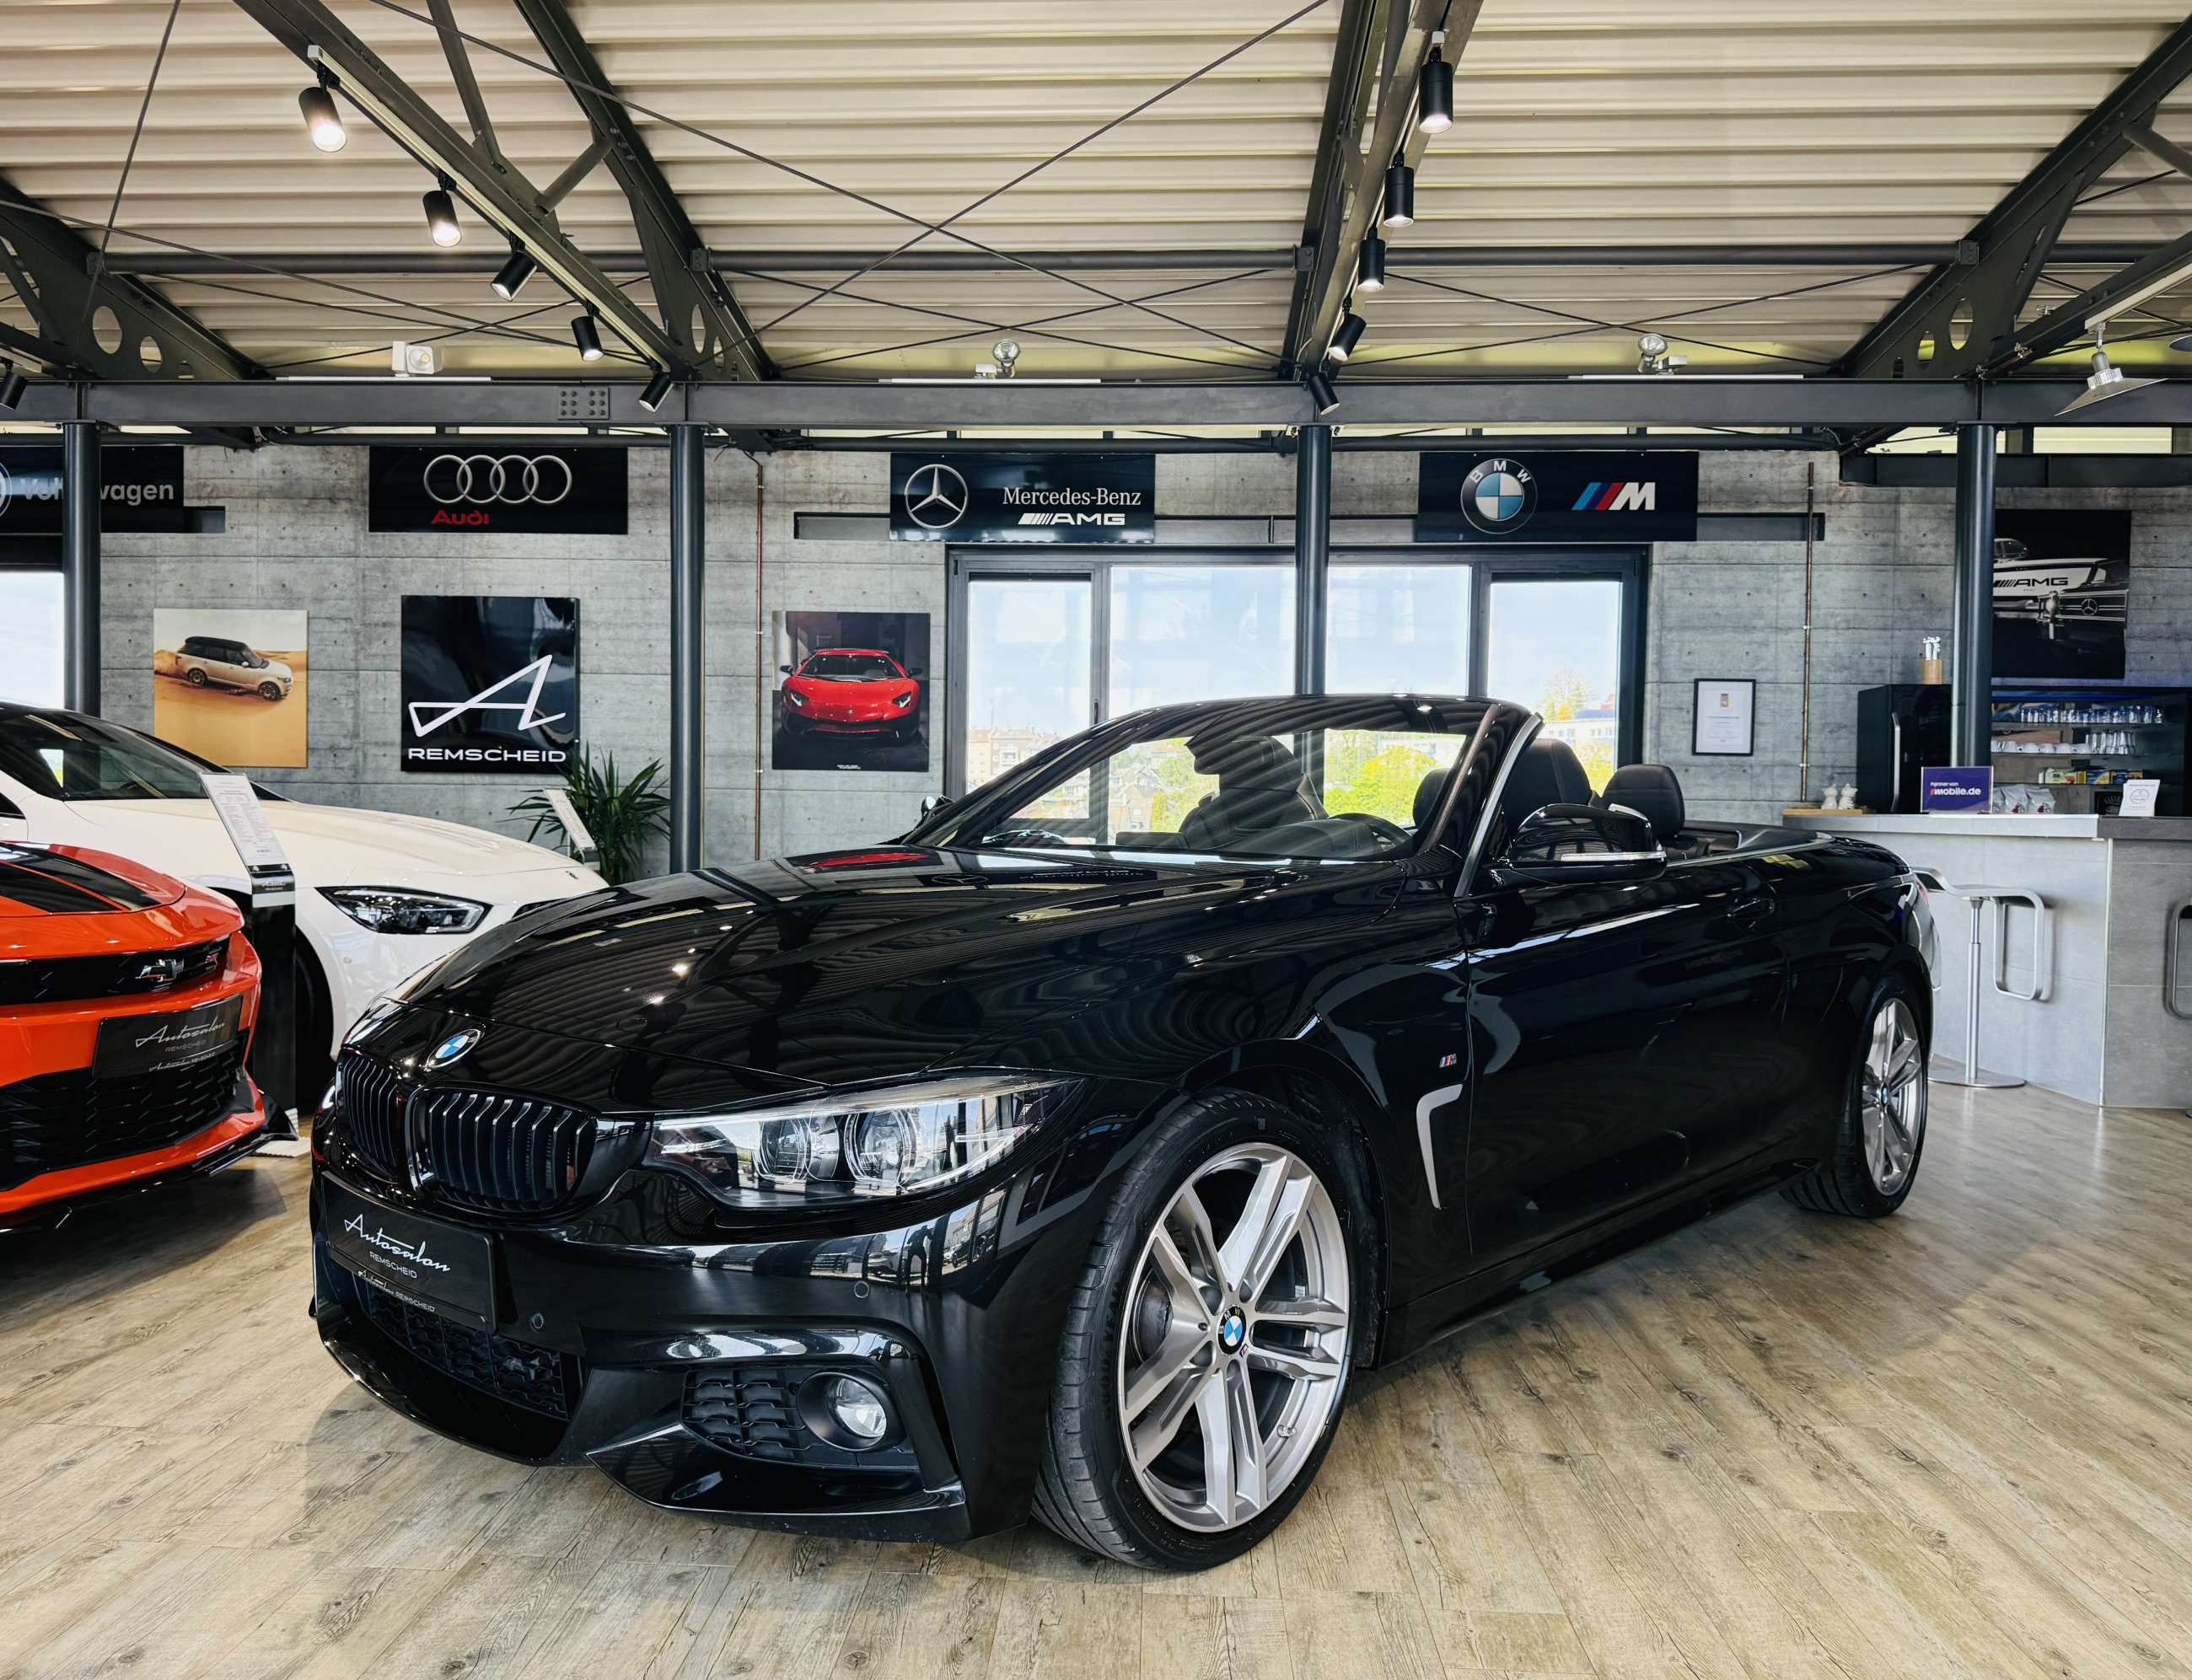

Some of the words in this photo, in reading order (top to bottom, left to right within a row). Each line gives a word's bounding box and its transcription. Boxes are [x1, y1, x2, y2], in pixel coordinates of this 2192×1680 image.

[1469, 460, 1531, 484] BMW
[1002, 486, 1142, 506] Mercedes-Benz
[431, 509, 491, 525] Audi
[1050, 513, 1126, 526] AMG
[2013, 577, 2068, 588] AMG
[408, 748, 567, 763] REMSCHEID
[136, 1016, 224, 1048] Autosalon
[344, 1214, 450, 1272] Autosalon
[369, 1251, 417, 1278] REMSCHEID
[395, 1291, 435, 1312] REMSCHEID
